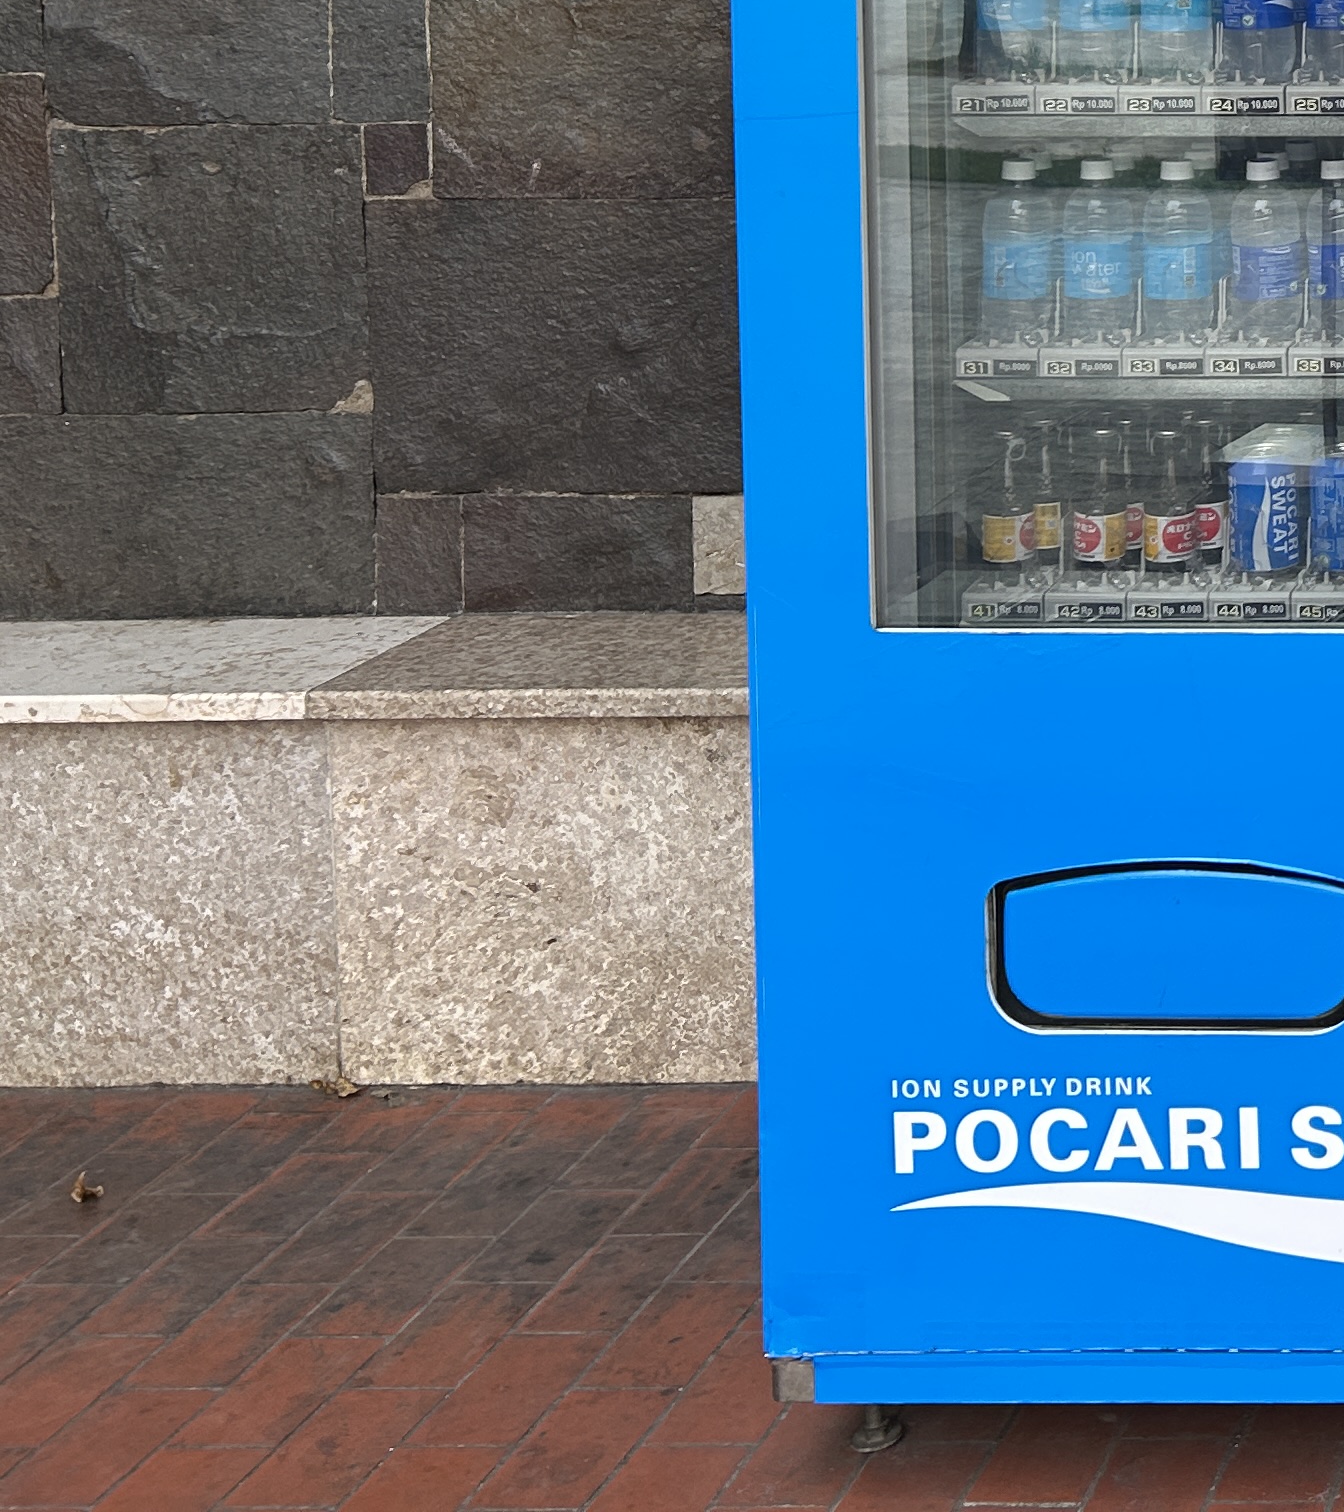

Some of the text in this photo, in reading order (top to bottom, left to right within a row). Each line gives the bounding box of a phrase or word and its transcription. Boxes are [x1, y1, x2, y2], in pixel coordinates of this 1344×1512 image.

[1044, 99, 1067, 112] 22
[1128, 99, 1150, 112] 23
[1153, 99, 1166, 111] Rp
[1211, 99, 1233, 111] 24
[1237, 99, 1250, 112] Rp
[1296, 98, 1334, 111] 25 Rp
[965, 361, 986, 374] 31
[1130, 360, 1154, 373] 33
[1214, 361, 1236, 373] 34
[1298, 361, 1320, 373] 35
[1271, 475, 1288, 554] SWEAT
[1058, 605, 1079, 618] 42
[1135, 605, 1158, 618] 43
[1163, 605, 1175, 617] Rp
[1218, 604, 1240, 616] 44
[1300, 606, 1322, 618] 45
[891, 1076, 1153, 1099] ION SUPPLY DRINK
[891, 1105, 1261, 1175] POCARI
